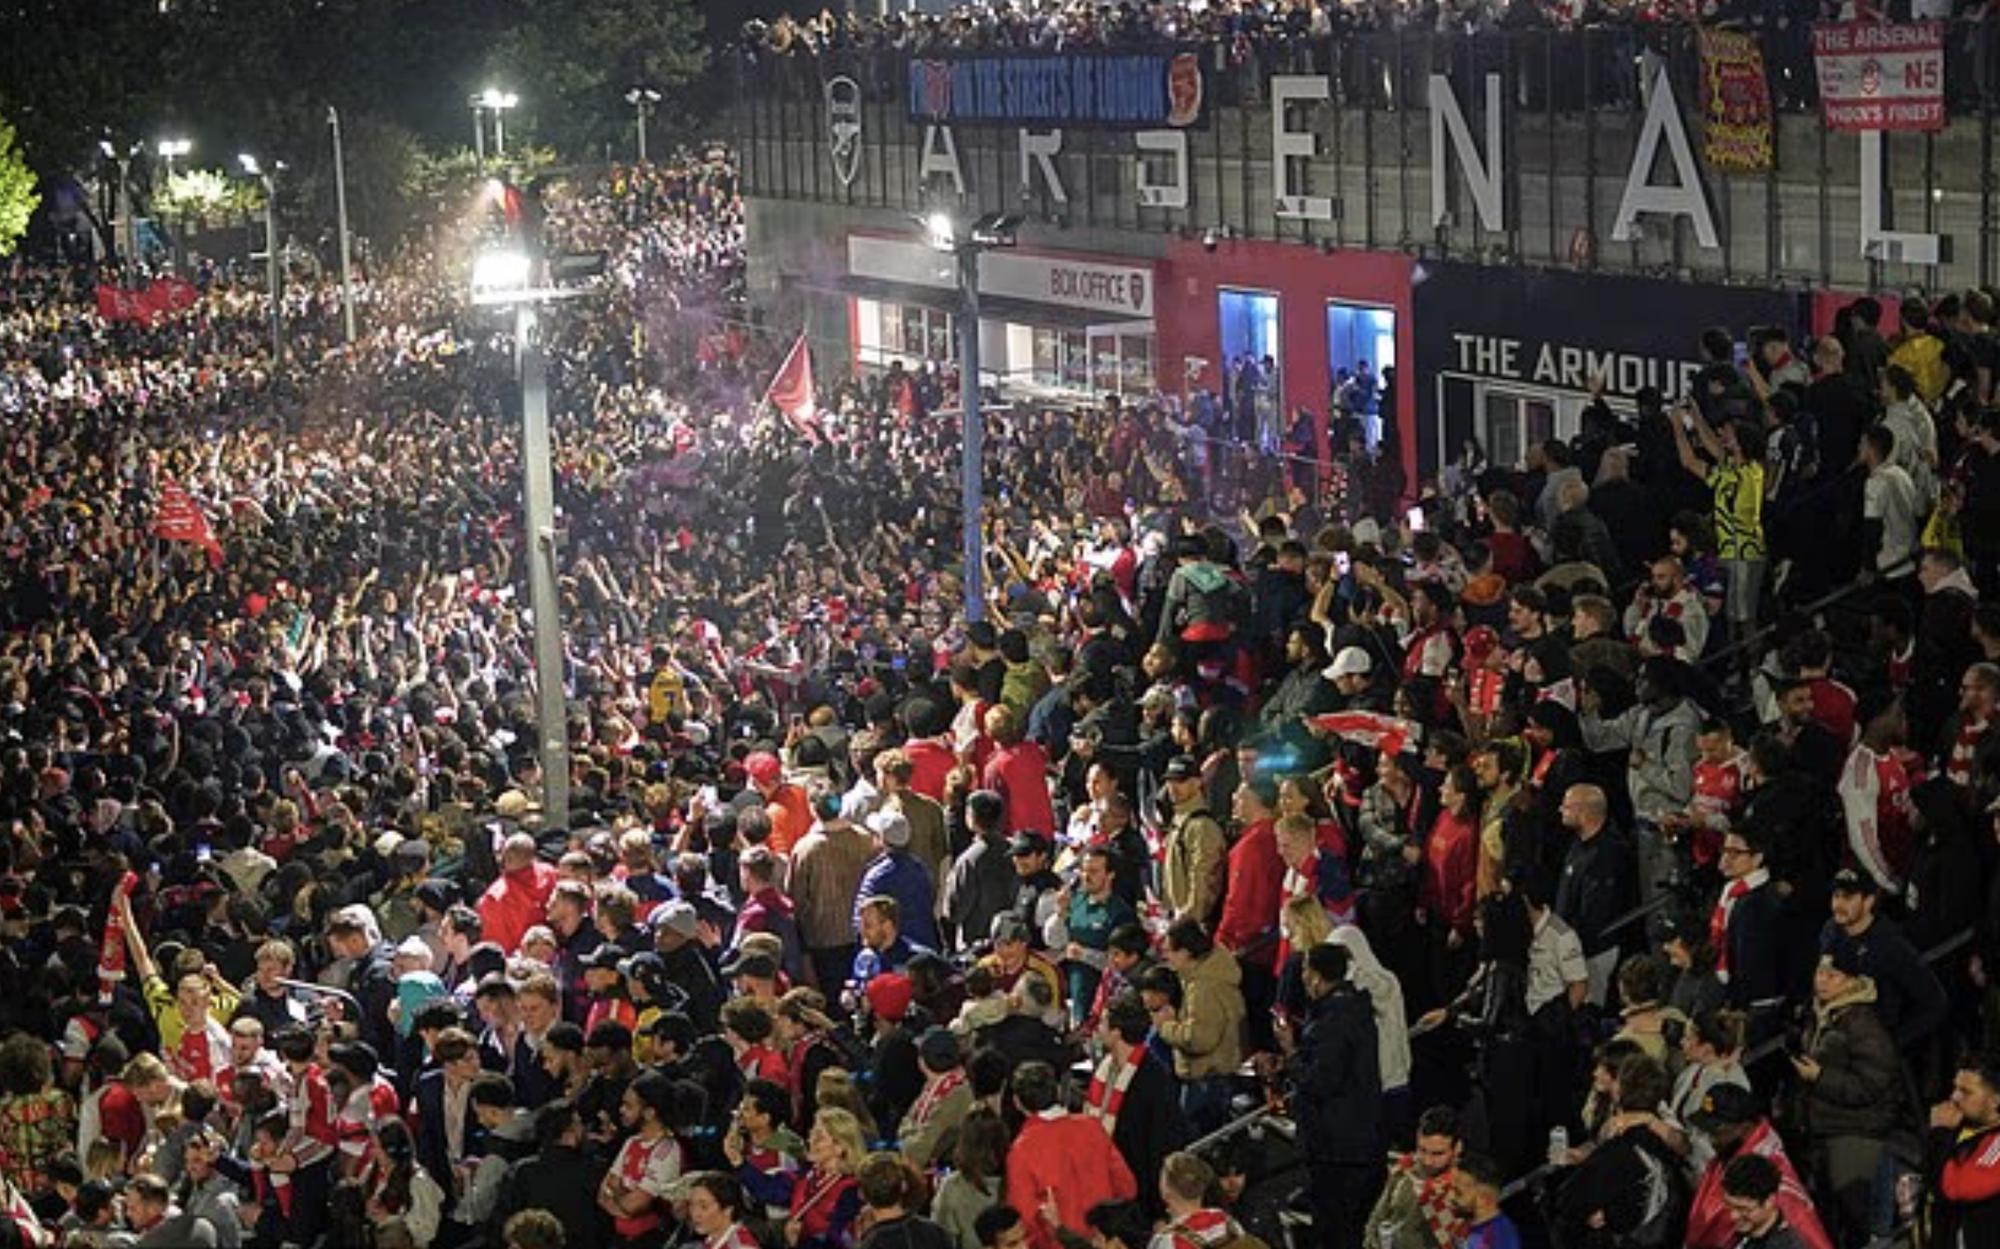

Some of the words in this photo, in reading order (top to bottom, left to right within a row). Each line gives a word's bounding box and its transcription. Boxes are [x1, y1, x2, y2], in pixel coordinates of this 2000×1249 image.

[1813, 30, 1850, 50] THE
[1853, 23, 1940, 48] ARSENAL
[975, 57, 1003, 117] THE
[1003, 56, 1071, 118] STREETS
[1073, 56, 1094, 118] OF
[1097, 56, 1165, 120] LONDON
[1904, 59, 1939, 89] N5
[1051, 268, 1078, 297] BOX
[1080, 270, 1125, 304] OFFICE
[1454, 333, 1521, 378] THE
[1533, 341, 1702, 402] ARMOUR
